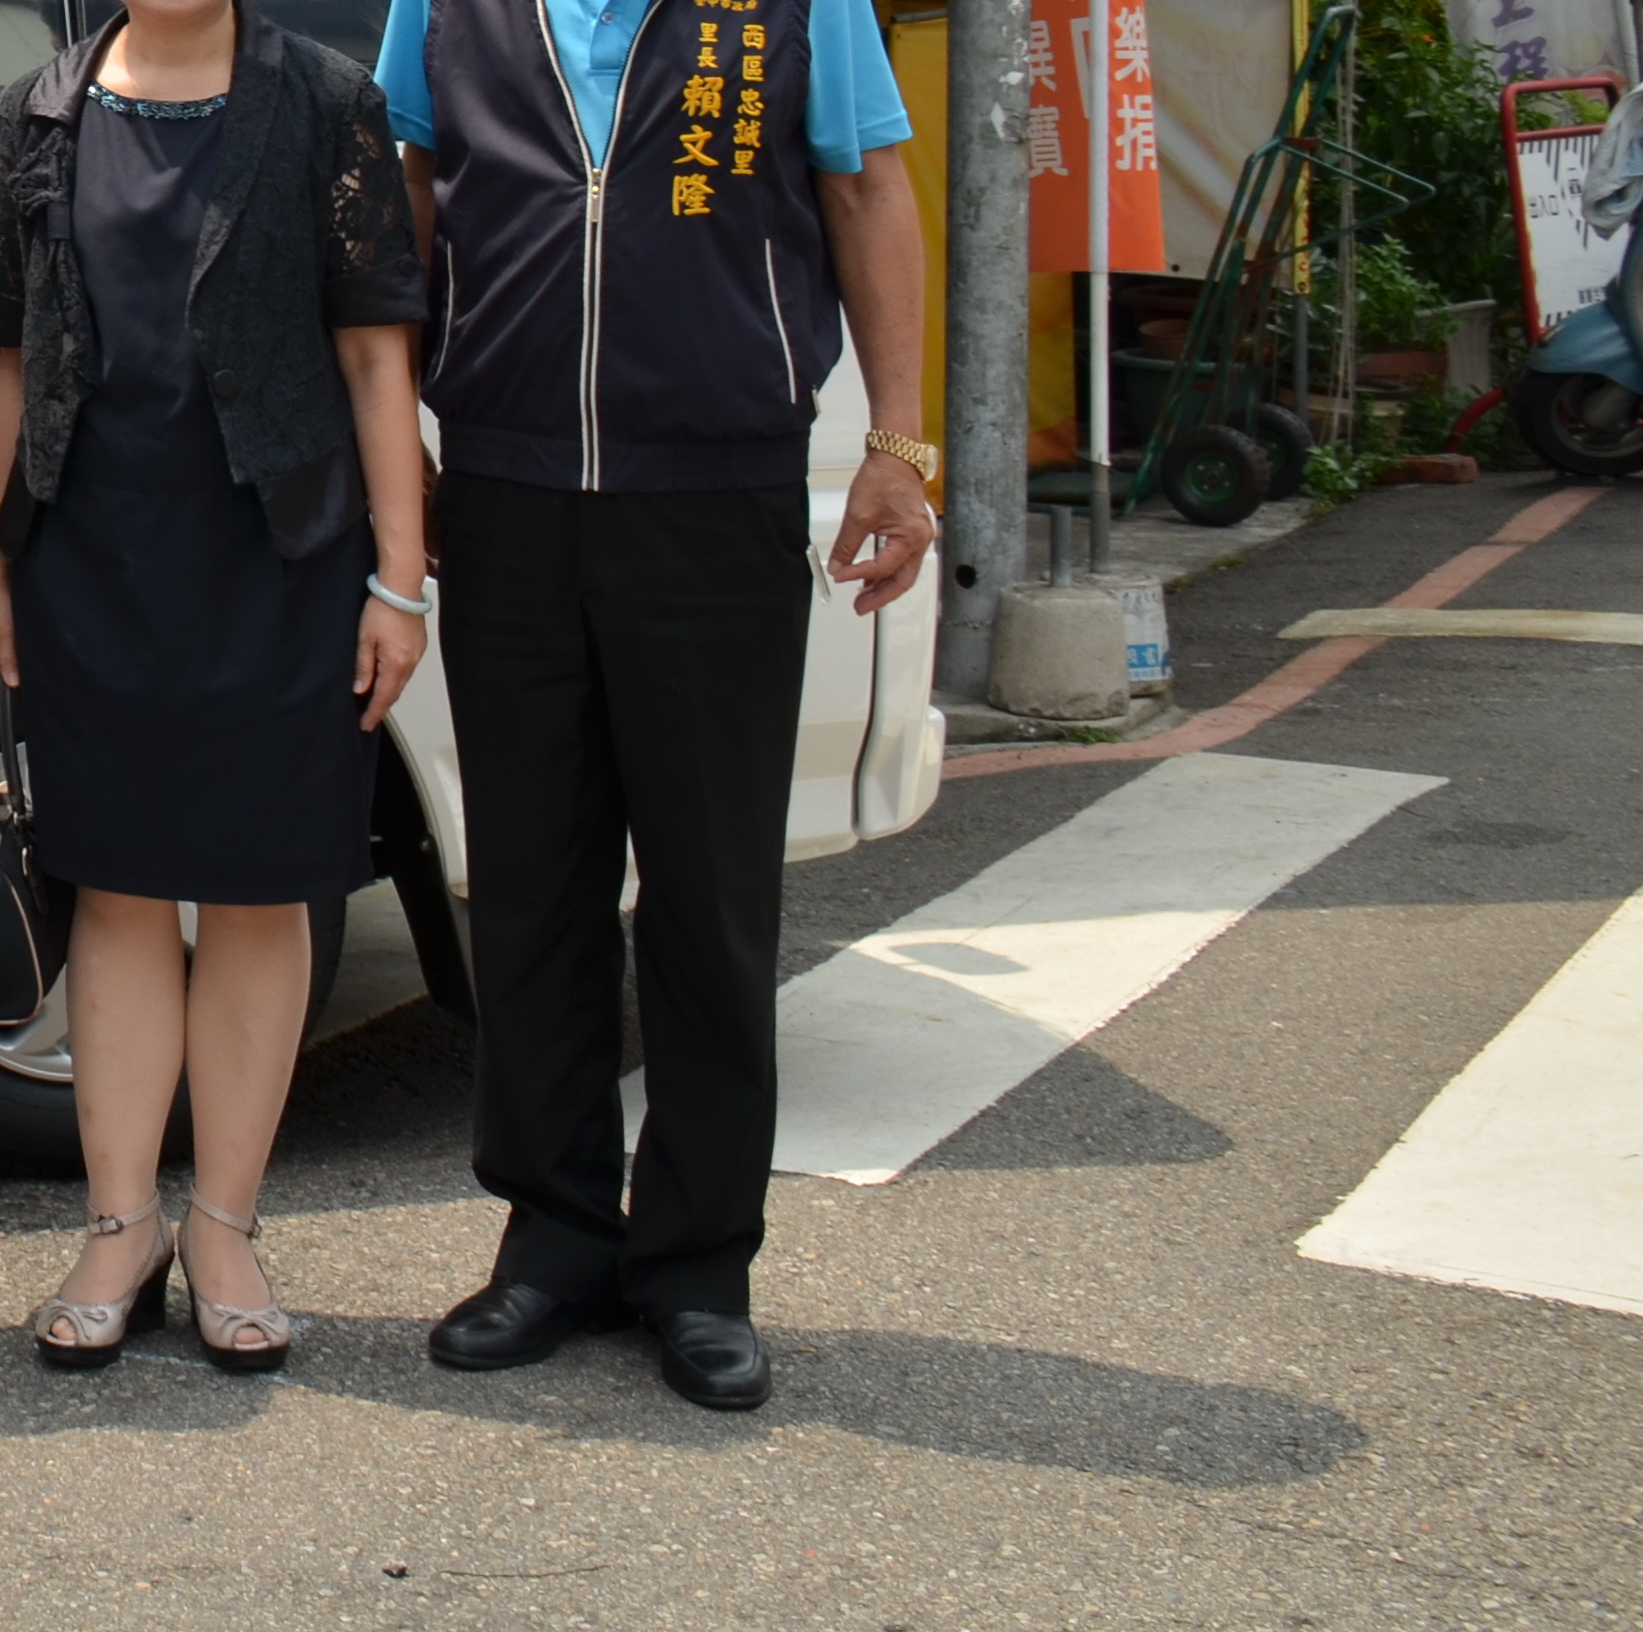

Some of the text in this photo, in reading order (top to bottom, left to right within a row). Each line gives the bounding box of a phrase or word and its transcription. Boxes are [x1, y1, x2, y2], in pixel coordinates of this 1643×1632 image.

[730, 23, 765, 176] 西區忠誠里
